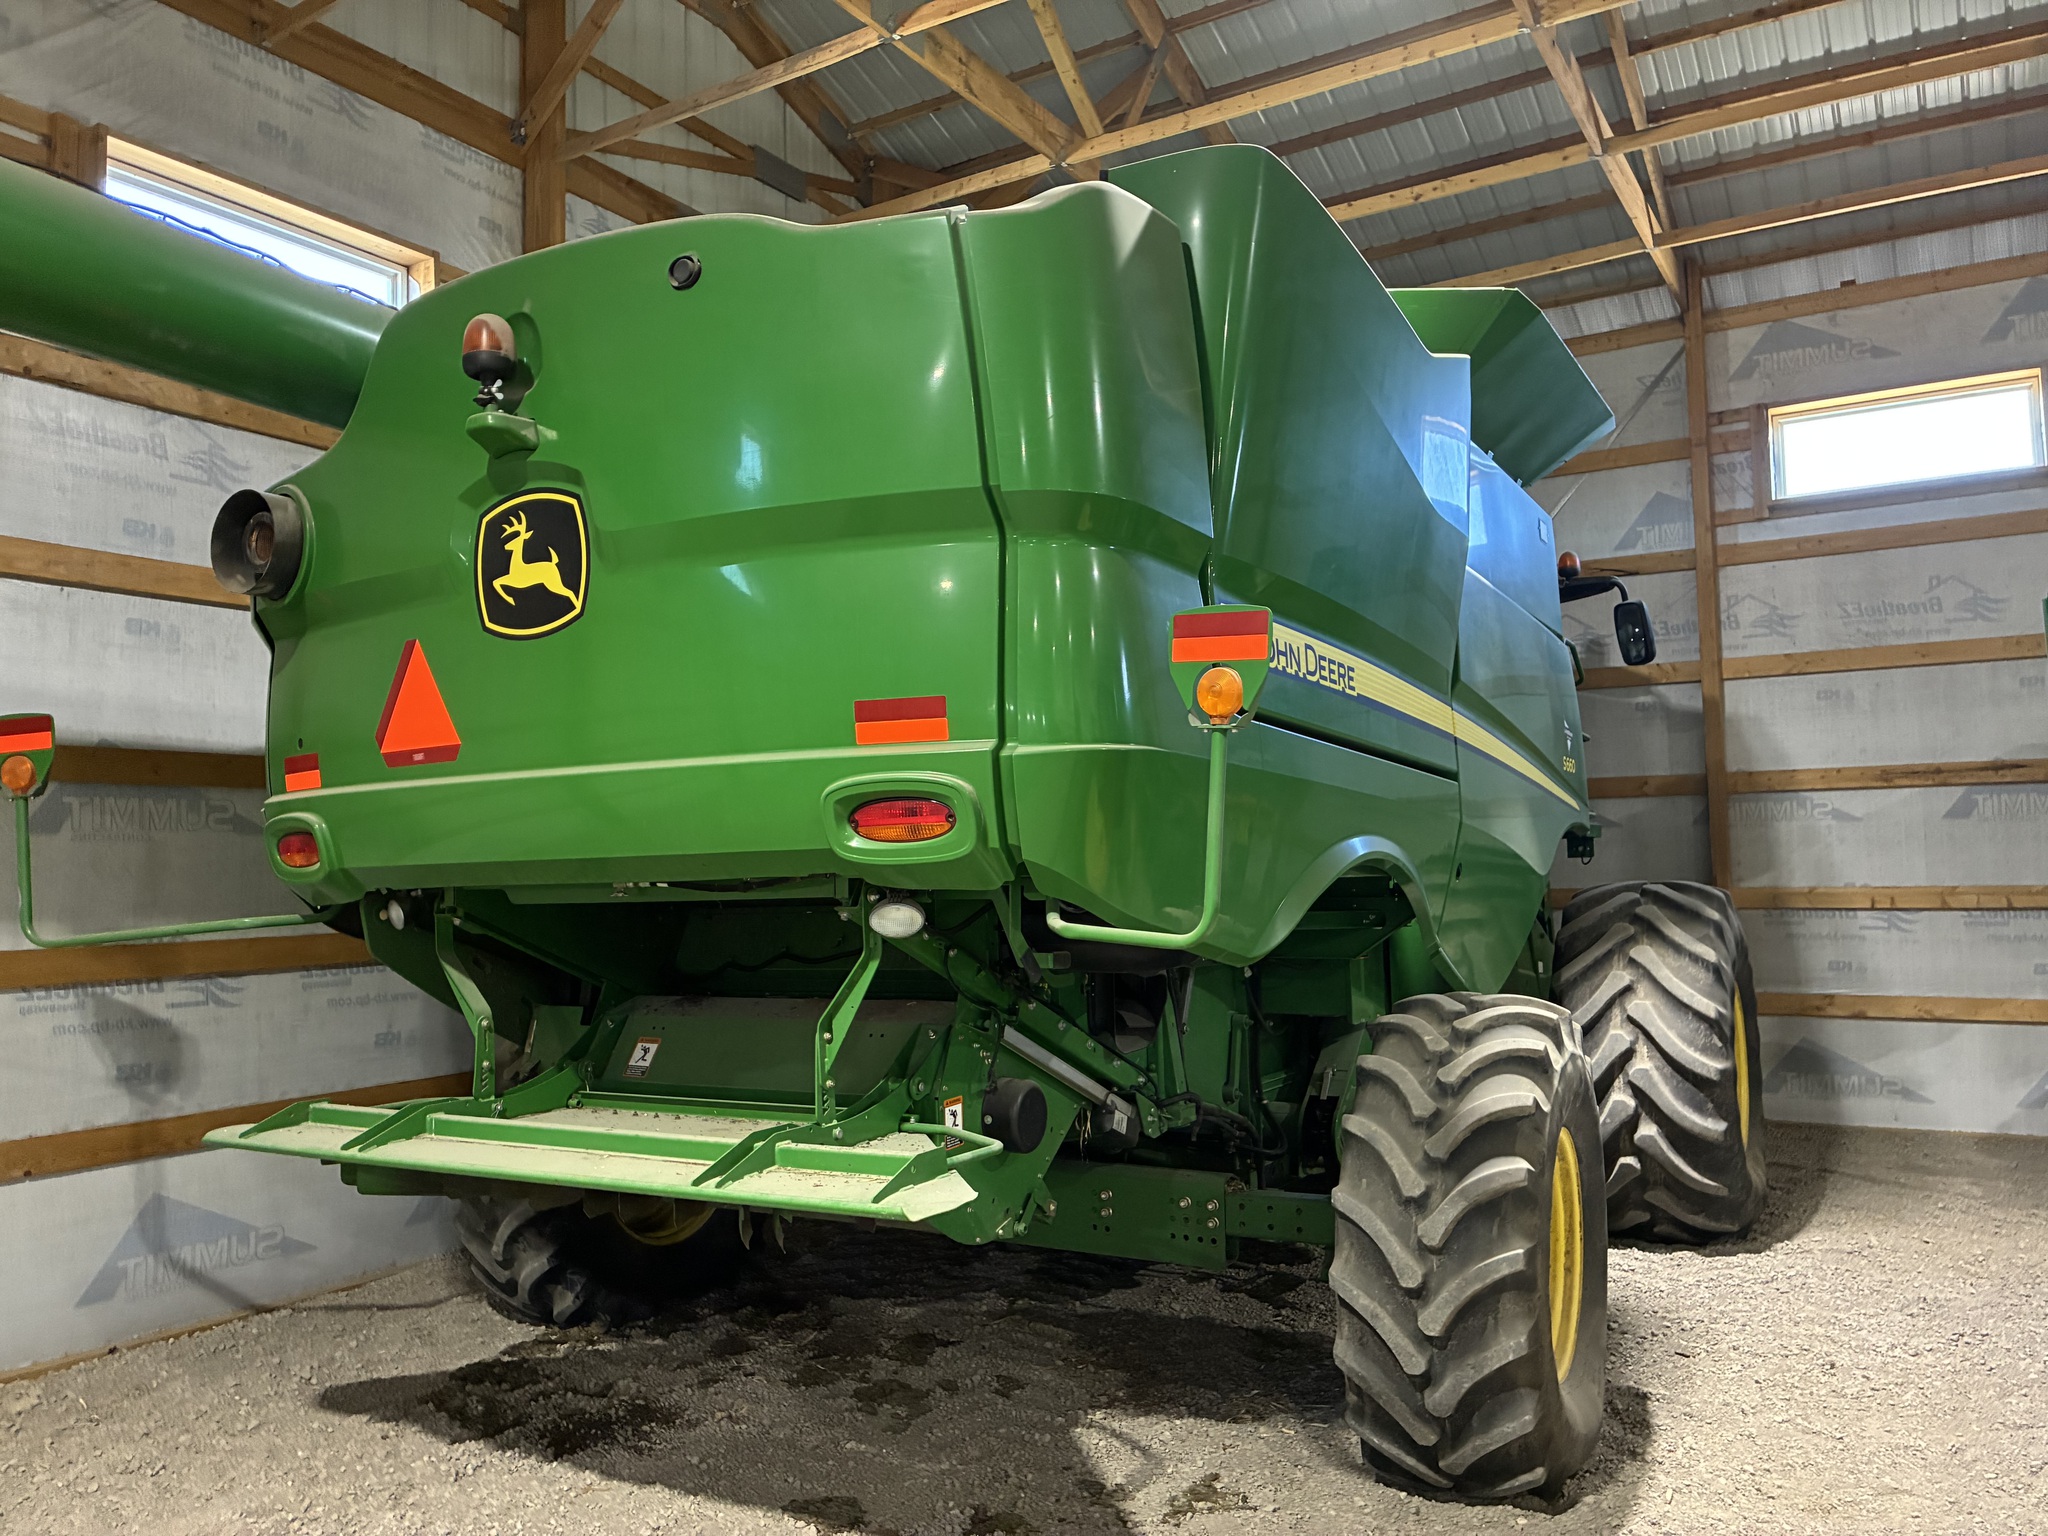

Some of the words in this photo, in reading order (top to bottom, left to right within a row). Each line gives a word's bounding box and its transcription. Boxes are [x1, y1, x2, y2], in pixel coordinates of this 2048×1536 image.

[1270, 637, 1301, 673] HN
[1304, 642, 1356, 692] DEERE
[1562, 755, 1576, 774] S660
